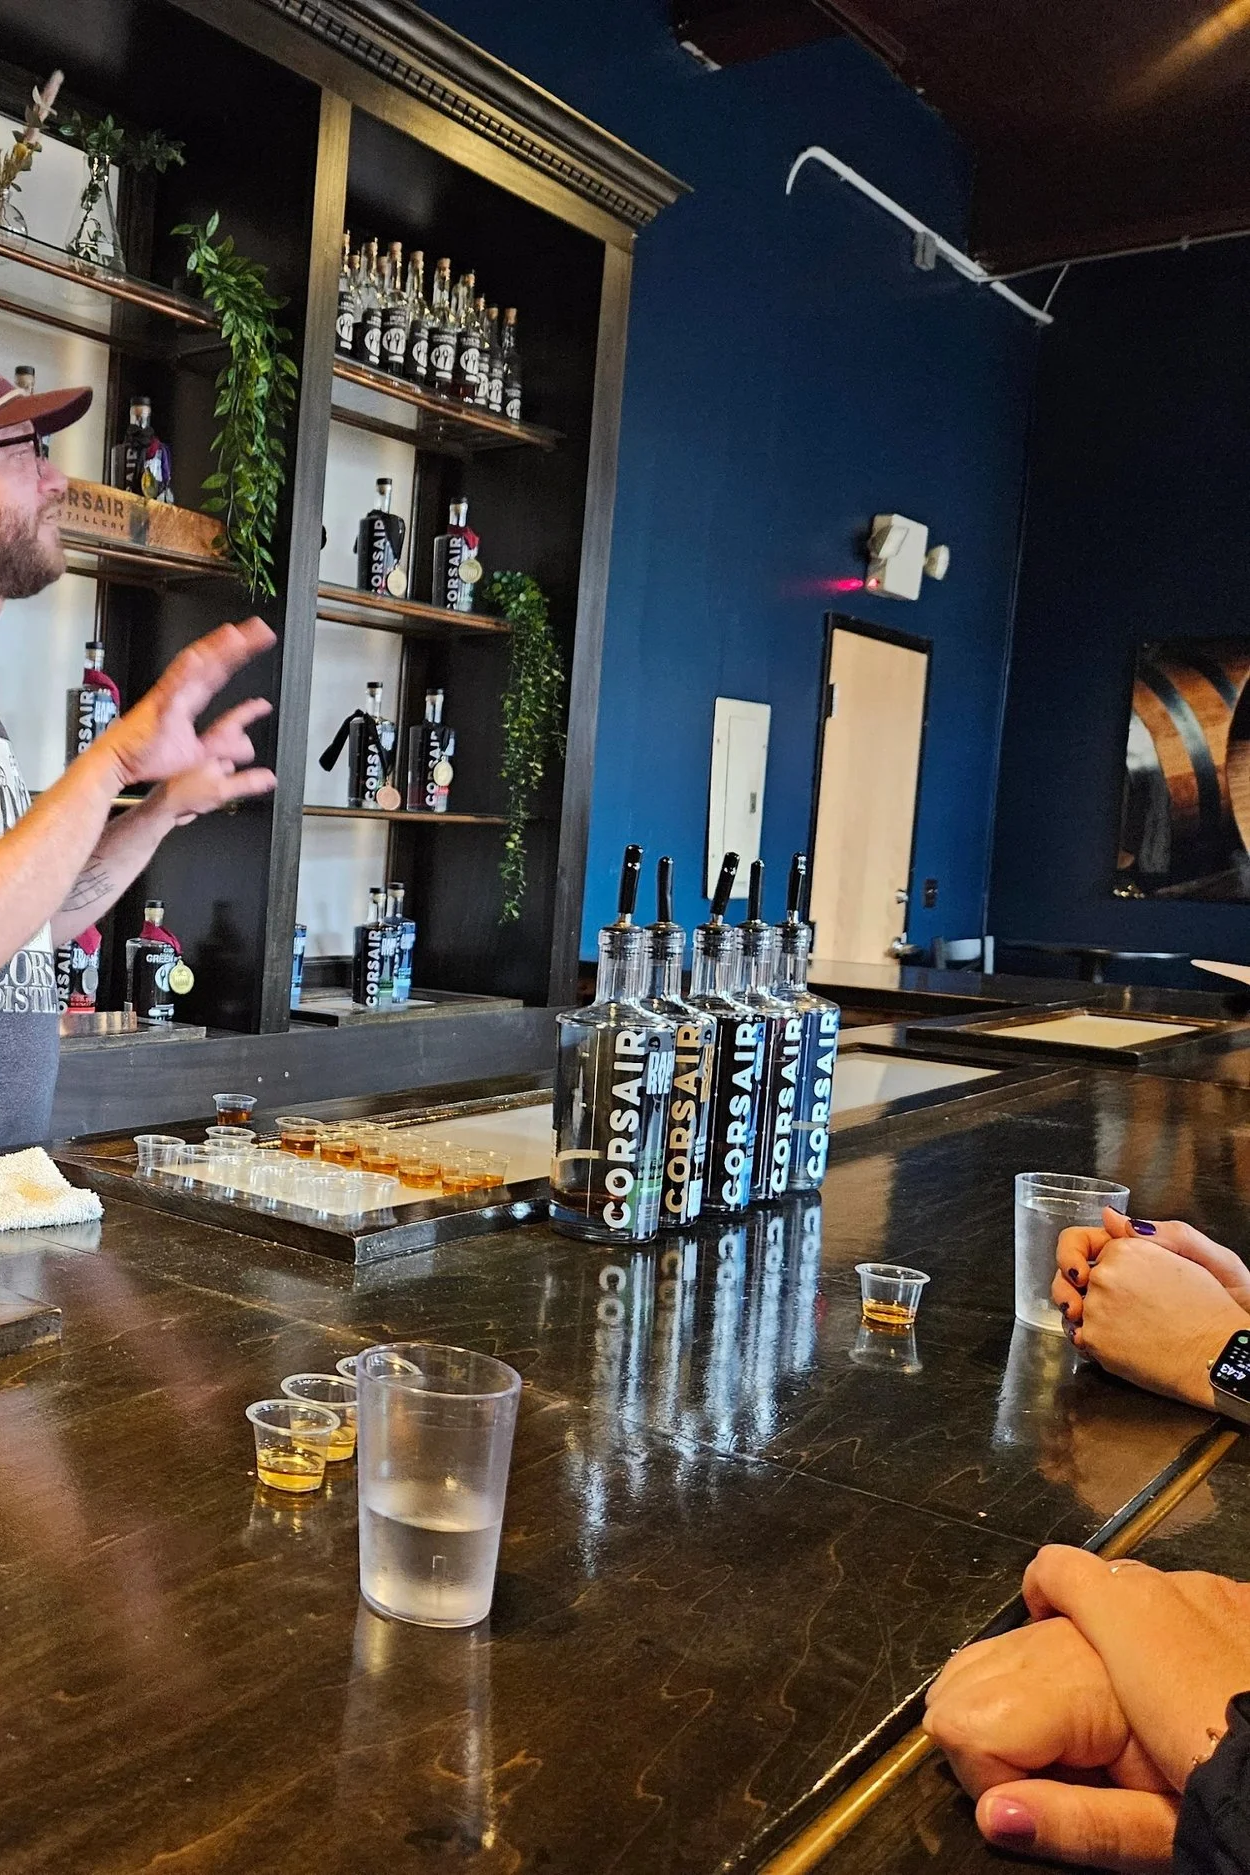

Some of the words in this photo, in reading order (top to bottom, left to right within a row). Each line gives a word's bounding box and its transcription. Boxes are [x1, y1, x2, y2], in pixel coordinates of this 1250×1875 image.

[366, 930, 381, 1007] CORSAIR
[603, 1029, 647, 1229] CORSAIR
[646, 1071, 672, 1094] RYE
[665, 1024, 701, 1213] CORSAIR
[722, 1022, 757, 1206] CORSAIR
[771, 1017, 803, 1193] CORSAIR
[807, 1010, 839, 1180] CORSAIR
[1220, 1363, 1247, 1380] 4:43
